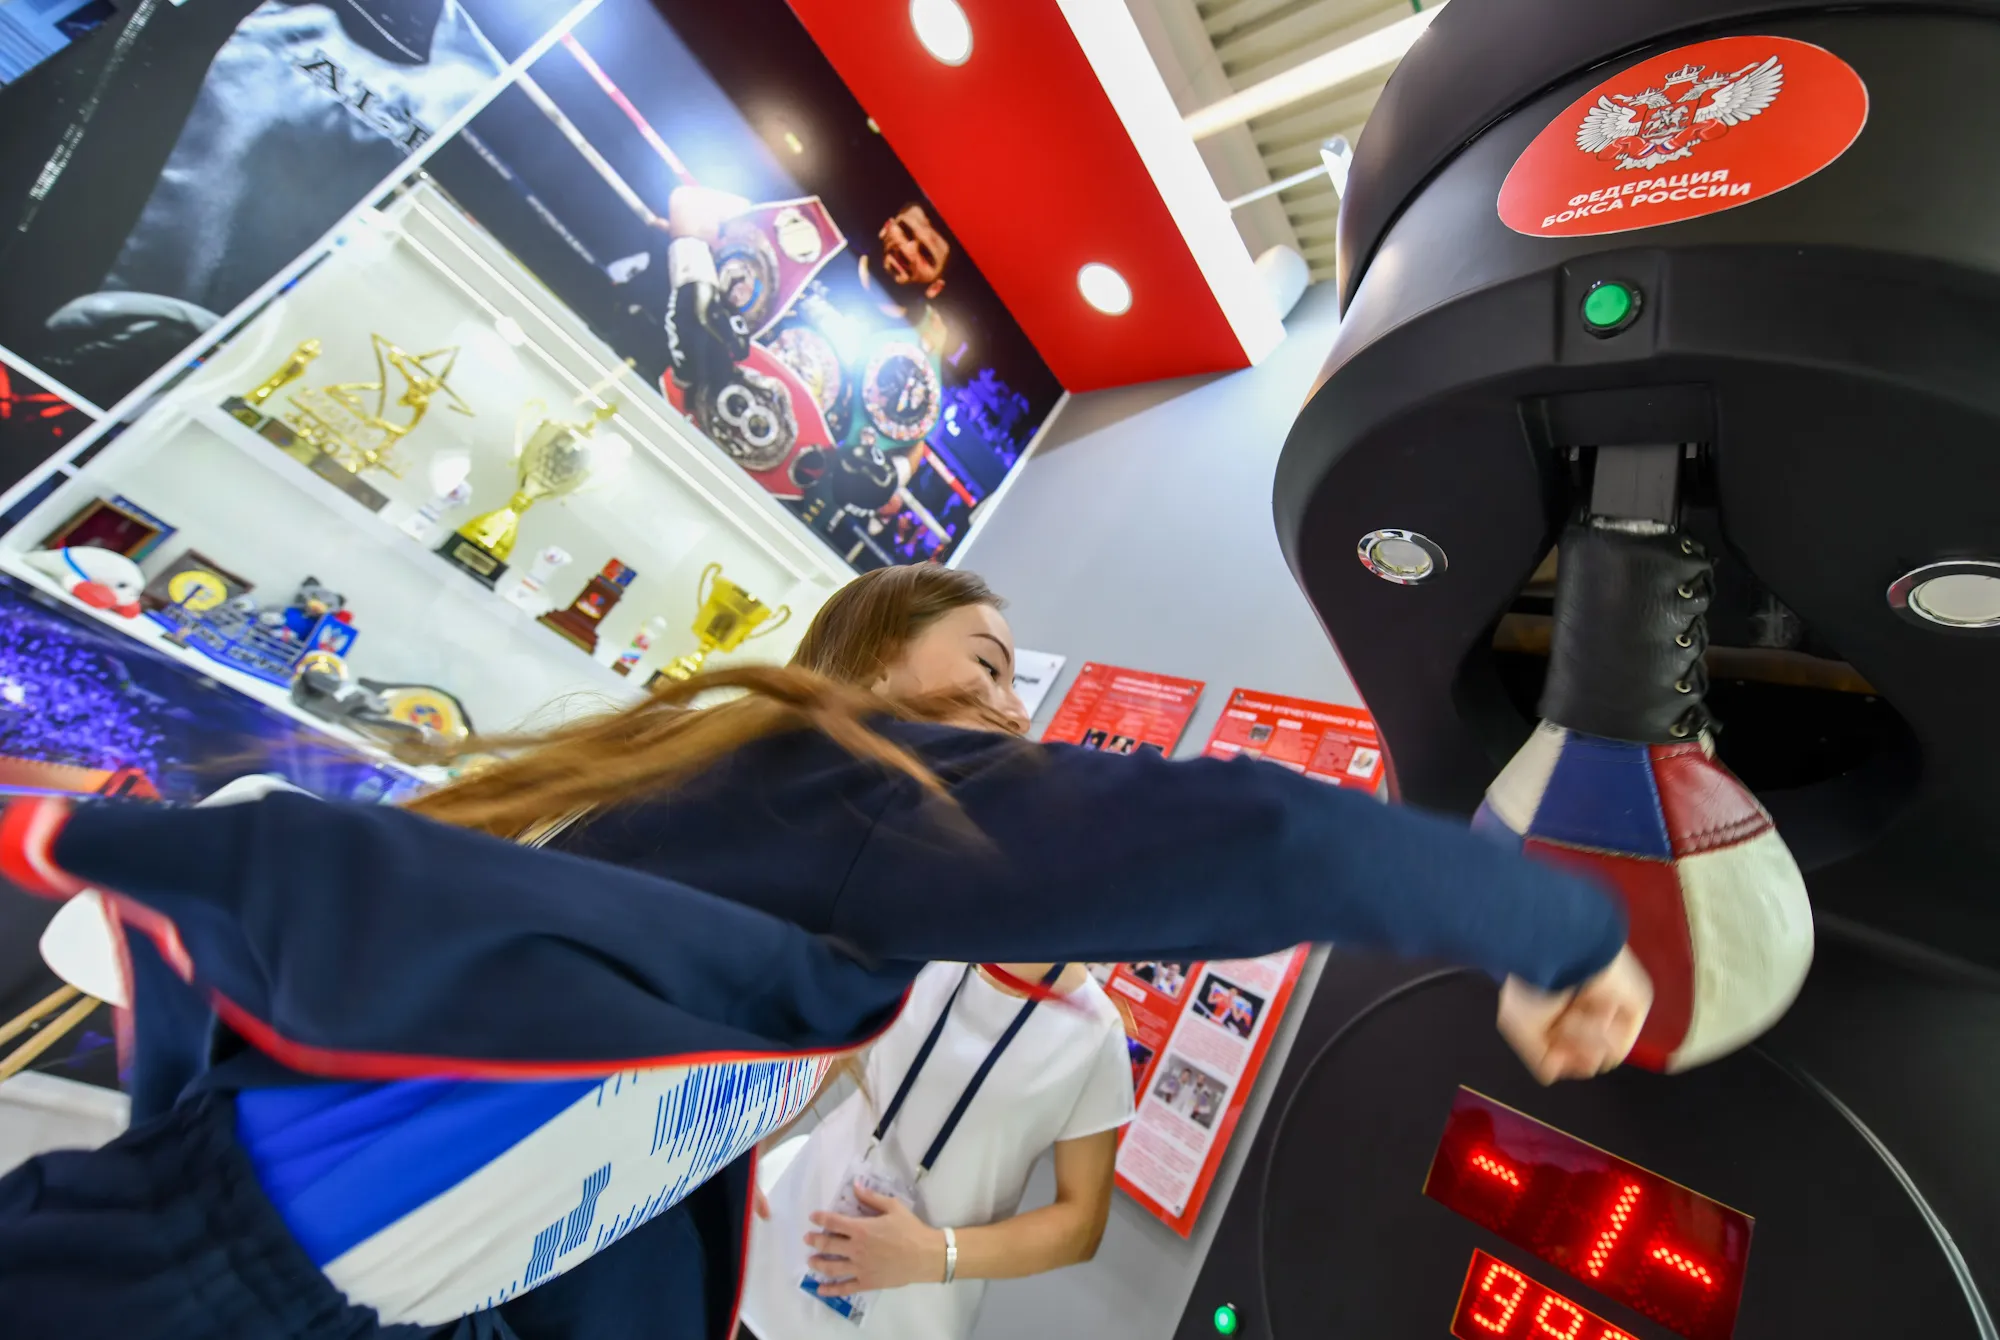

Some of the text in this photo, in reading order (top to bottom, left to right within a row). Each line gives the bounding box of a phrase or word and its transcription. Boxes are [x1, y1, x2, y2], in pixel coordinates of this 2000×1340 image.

[1541, 182, 1752, 229] БОКСА РОССИИ
[1567, 168, 1730, 207] ФЕДЕРАЦИЯ
